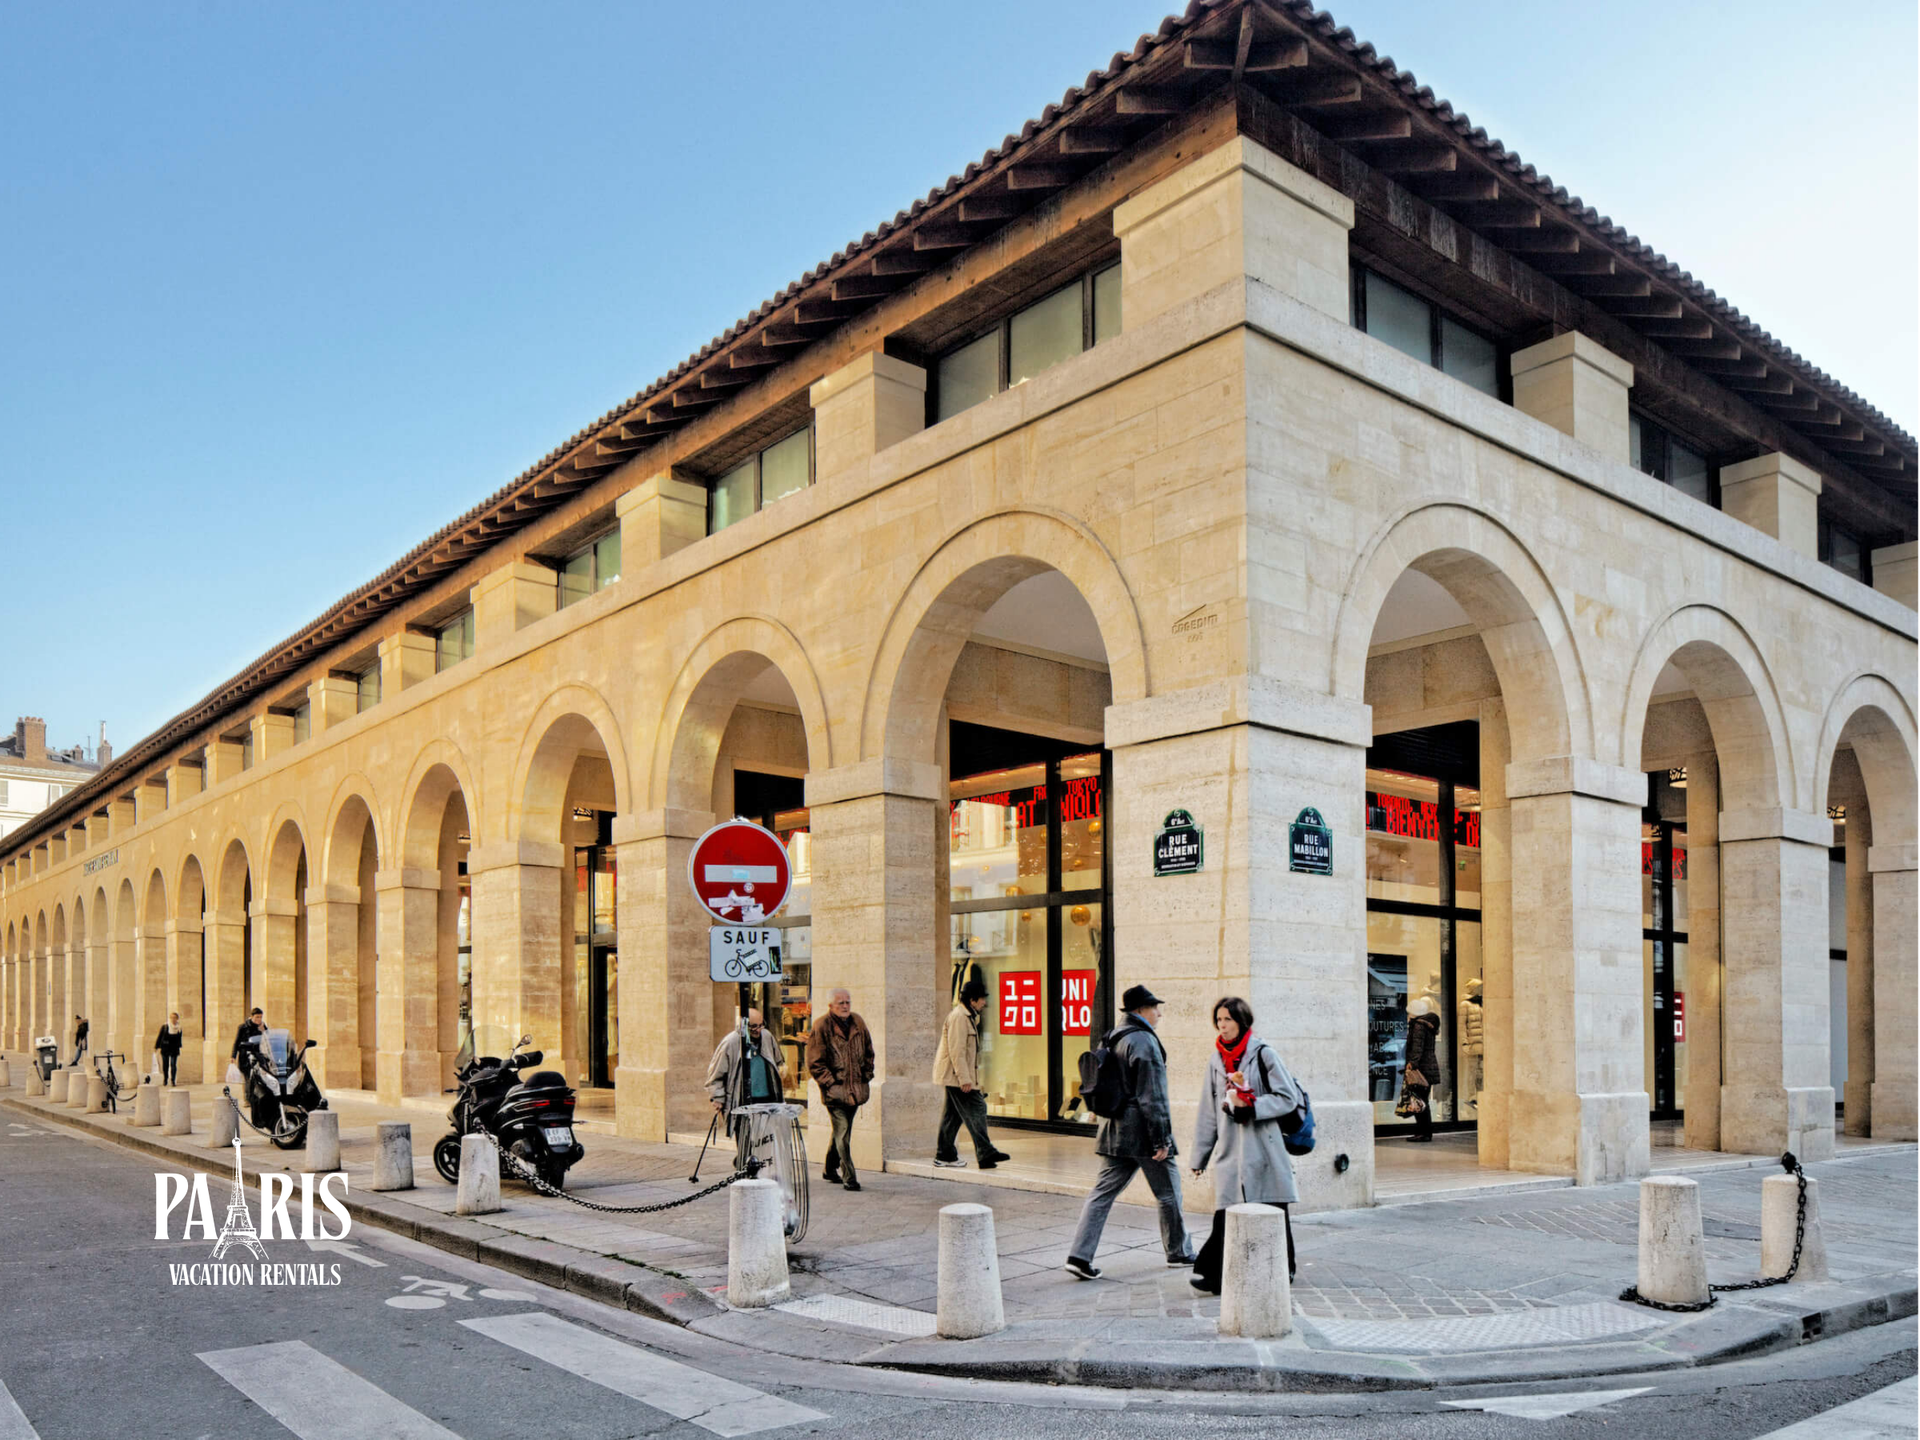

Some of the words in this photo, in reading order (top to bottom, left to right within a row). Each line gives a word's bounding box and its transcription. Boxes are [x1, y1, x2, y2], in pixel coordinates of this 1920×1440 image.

[1169, 834, 1188, 846] RUE
[1304, 834, 1319, 845] RUE
[1294, 843, 1329, 858] MABILLON
[723, 930, 770, 945] SAUF
